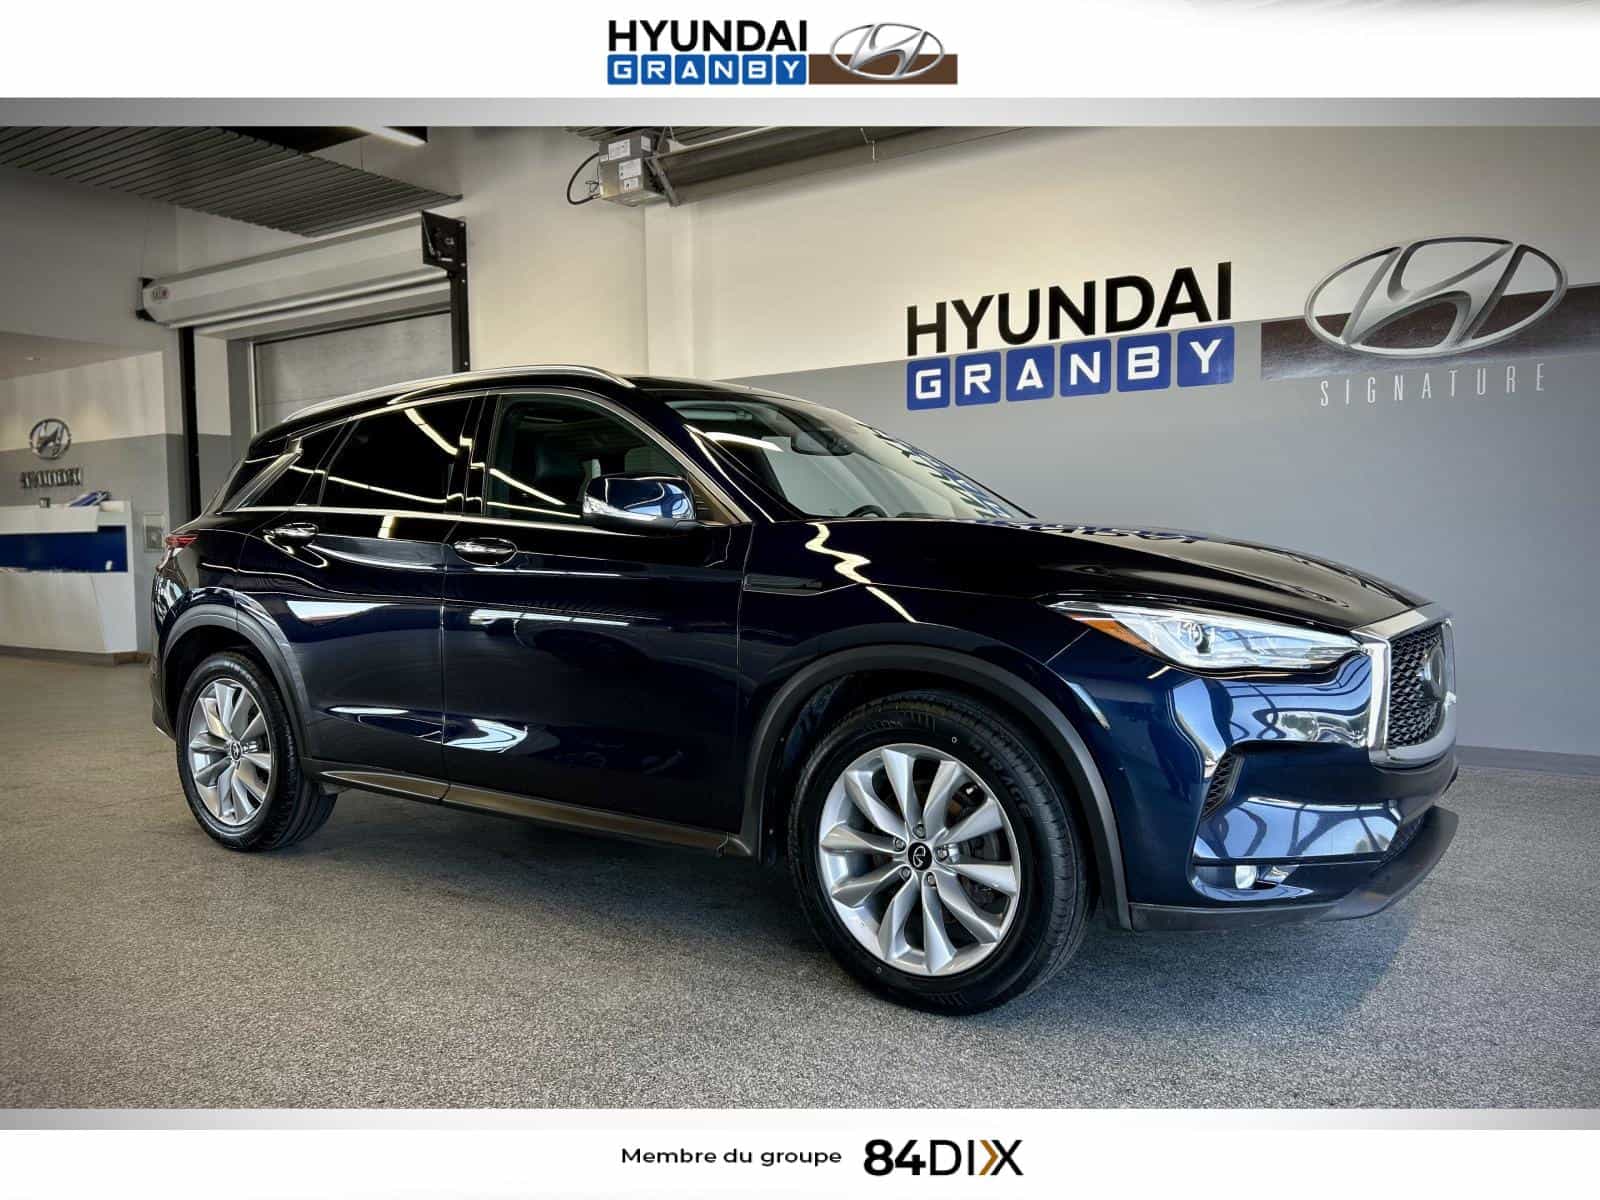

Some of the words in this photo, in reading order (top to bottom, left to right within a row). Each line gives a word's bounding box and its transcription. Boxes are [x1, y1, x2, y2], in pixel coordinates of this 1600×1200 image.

[907, 262, 1231, 356] HYUNDAI
[915, 339, 1222, 400] GRANBY
[1320, 363, 1545, 407] SIGNATURE
